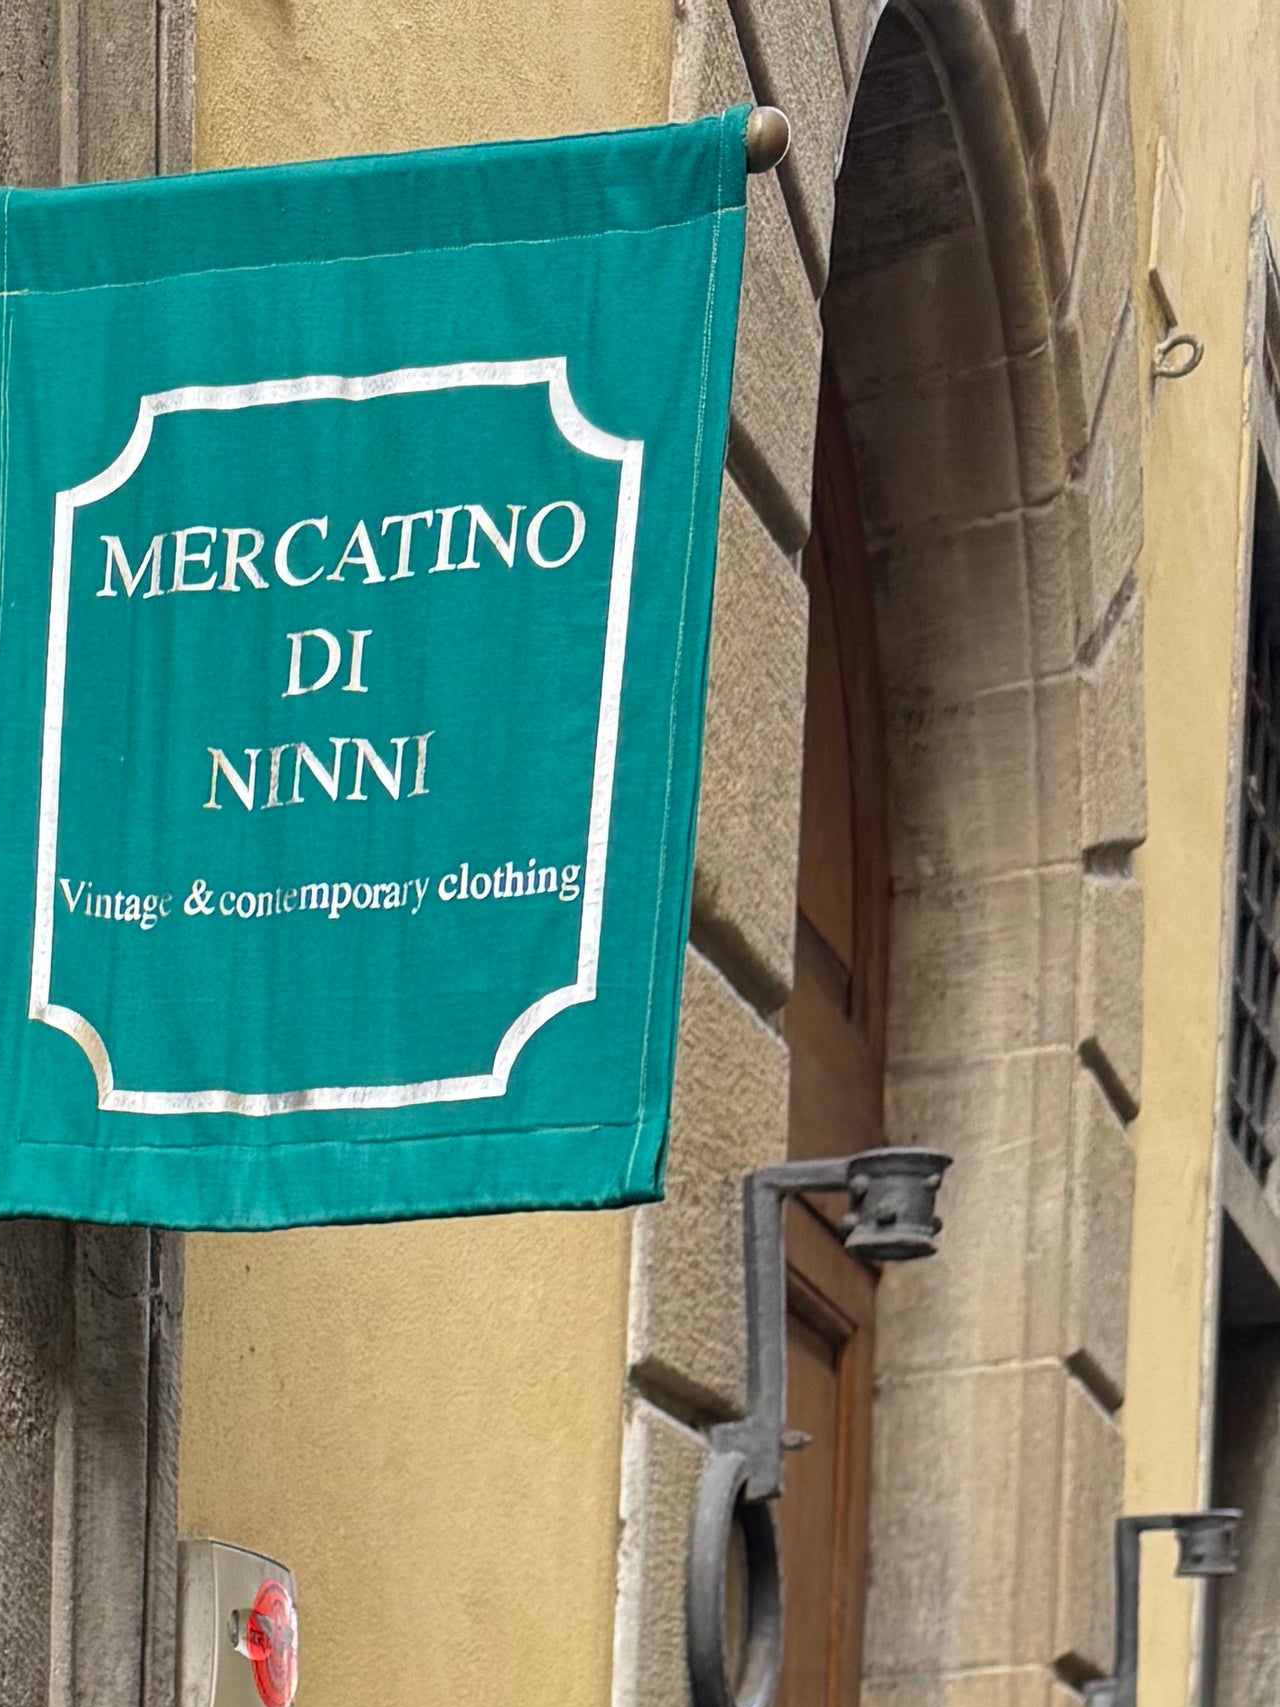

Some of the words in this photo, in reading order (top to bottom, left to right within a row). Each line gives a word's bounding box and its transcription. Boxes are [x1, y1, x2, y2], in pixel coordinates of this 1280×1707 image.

[96, 501, 586, 599] MERCATINO
[281, 628, 373, 698] DI
[202, 730, 436, 812] NINNI
[58, 878, 173, 930] Vintage
[183, 878, 216, 917] &
[218, 874, 430, 919] contemporary
[437, 857, 582, 901] clothing
